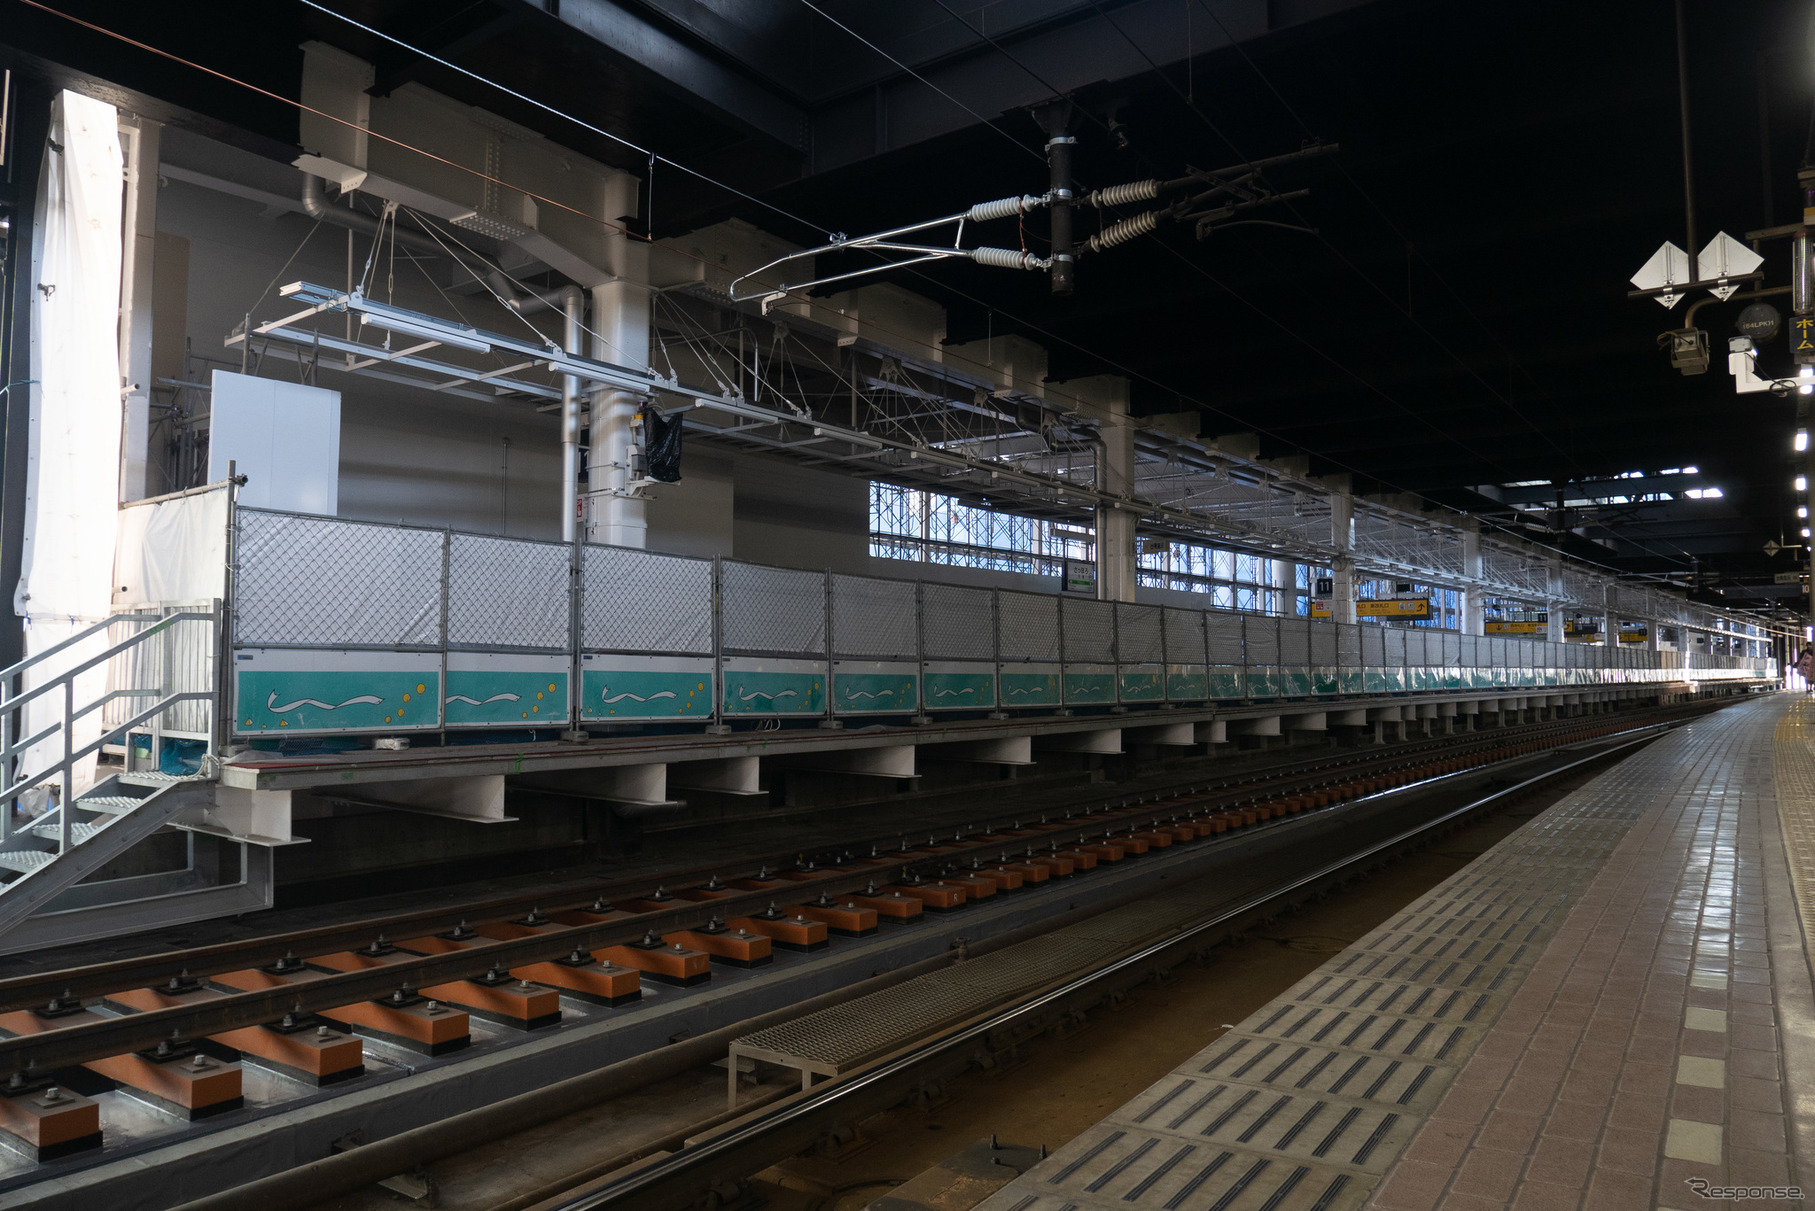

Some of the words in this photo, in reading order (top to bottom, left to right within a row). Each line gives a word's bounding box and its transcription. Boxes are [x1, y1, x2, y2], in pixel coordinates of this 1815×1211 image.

[1796, 318, 1815, 350] ホーム
[1319, 581, 1330, 592] 11
[1801, 584, 1810, 594] 10
